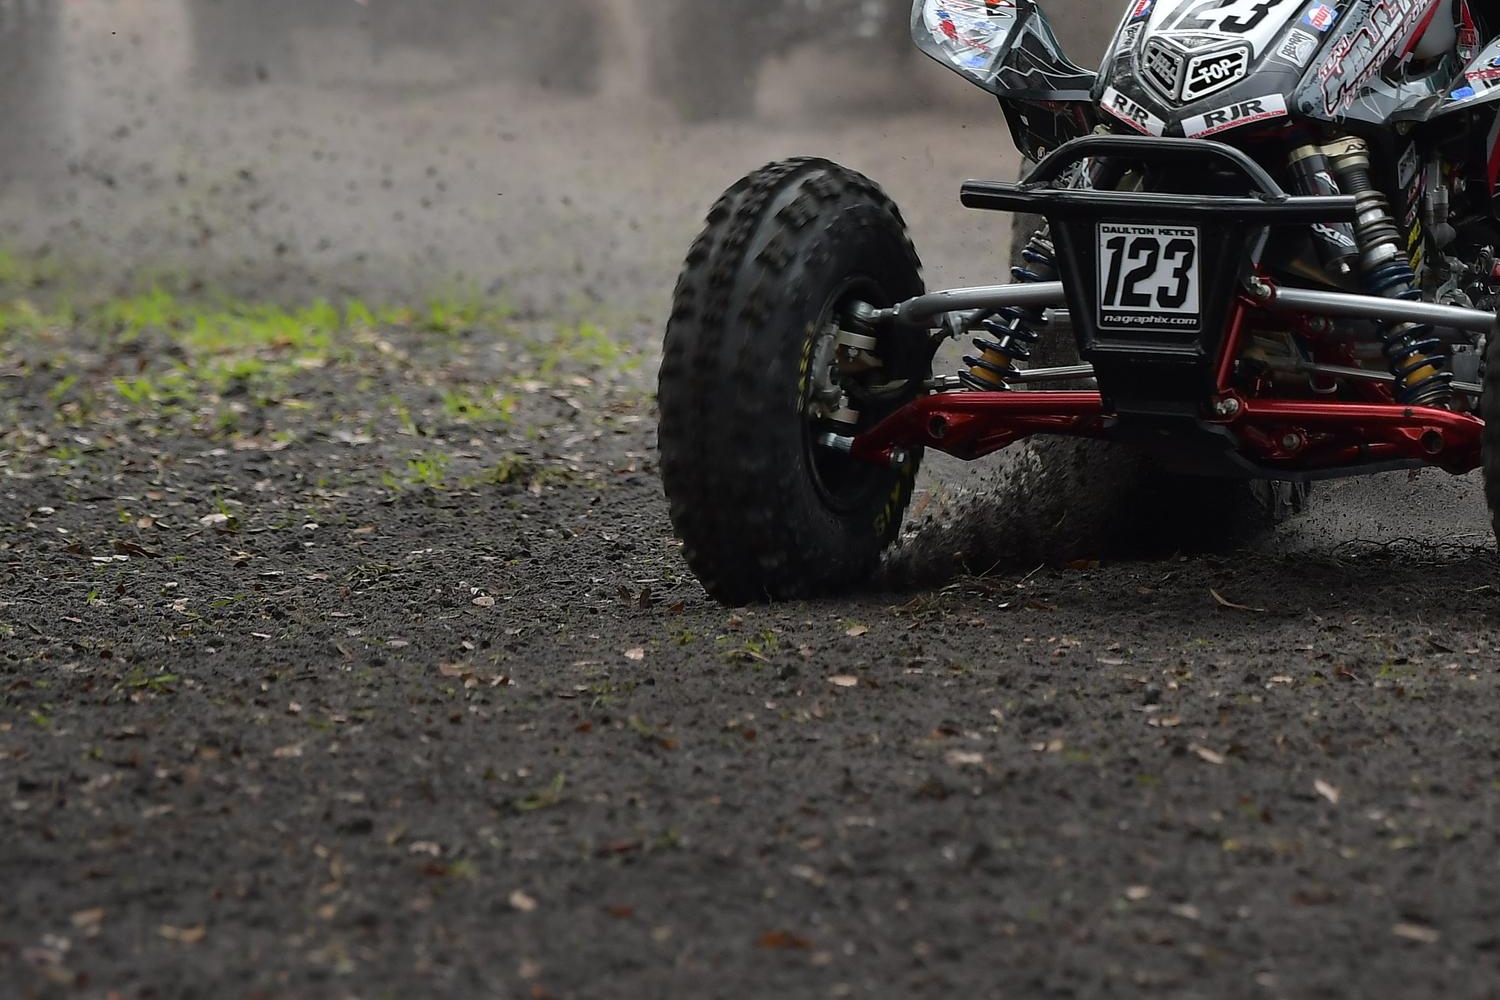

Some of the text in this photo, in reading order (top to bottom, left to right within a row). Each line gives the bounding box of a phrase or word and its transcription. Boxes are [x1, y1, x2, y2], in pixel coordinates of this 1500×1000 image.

[1198, 58, 1234, 84] TOP
[1112, 93, 1150, 128] RJR
[1203, 99, 1266, 129] RJR
[1102, 226, 1196, 237] DAULTON KEYES
[1102, 236, 1196, 309] 123
[1103, 315, 1198, 325] nagraphix.com
